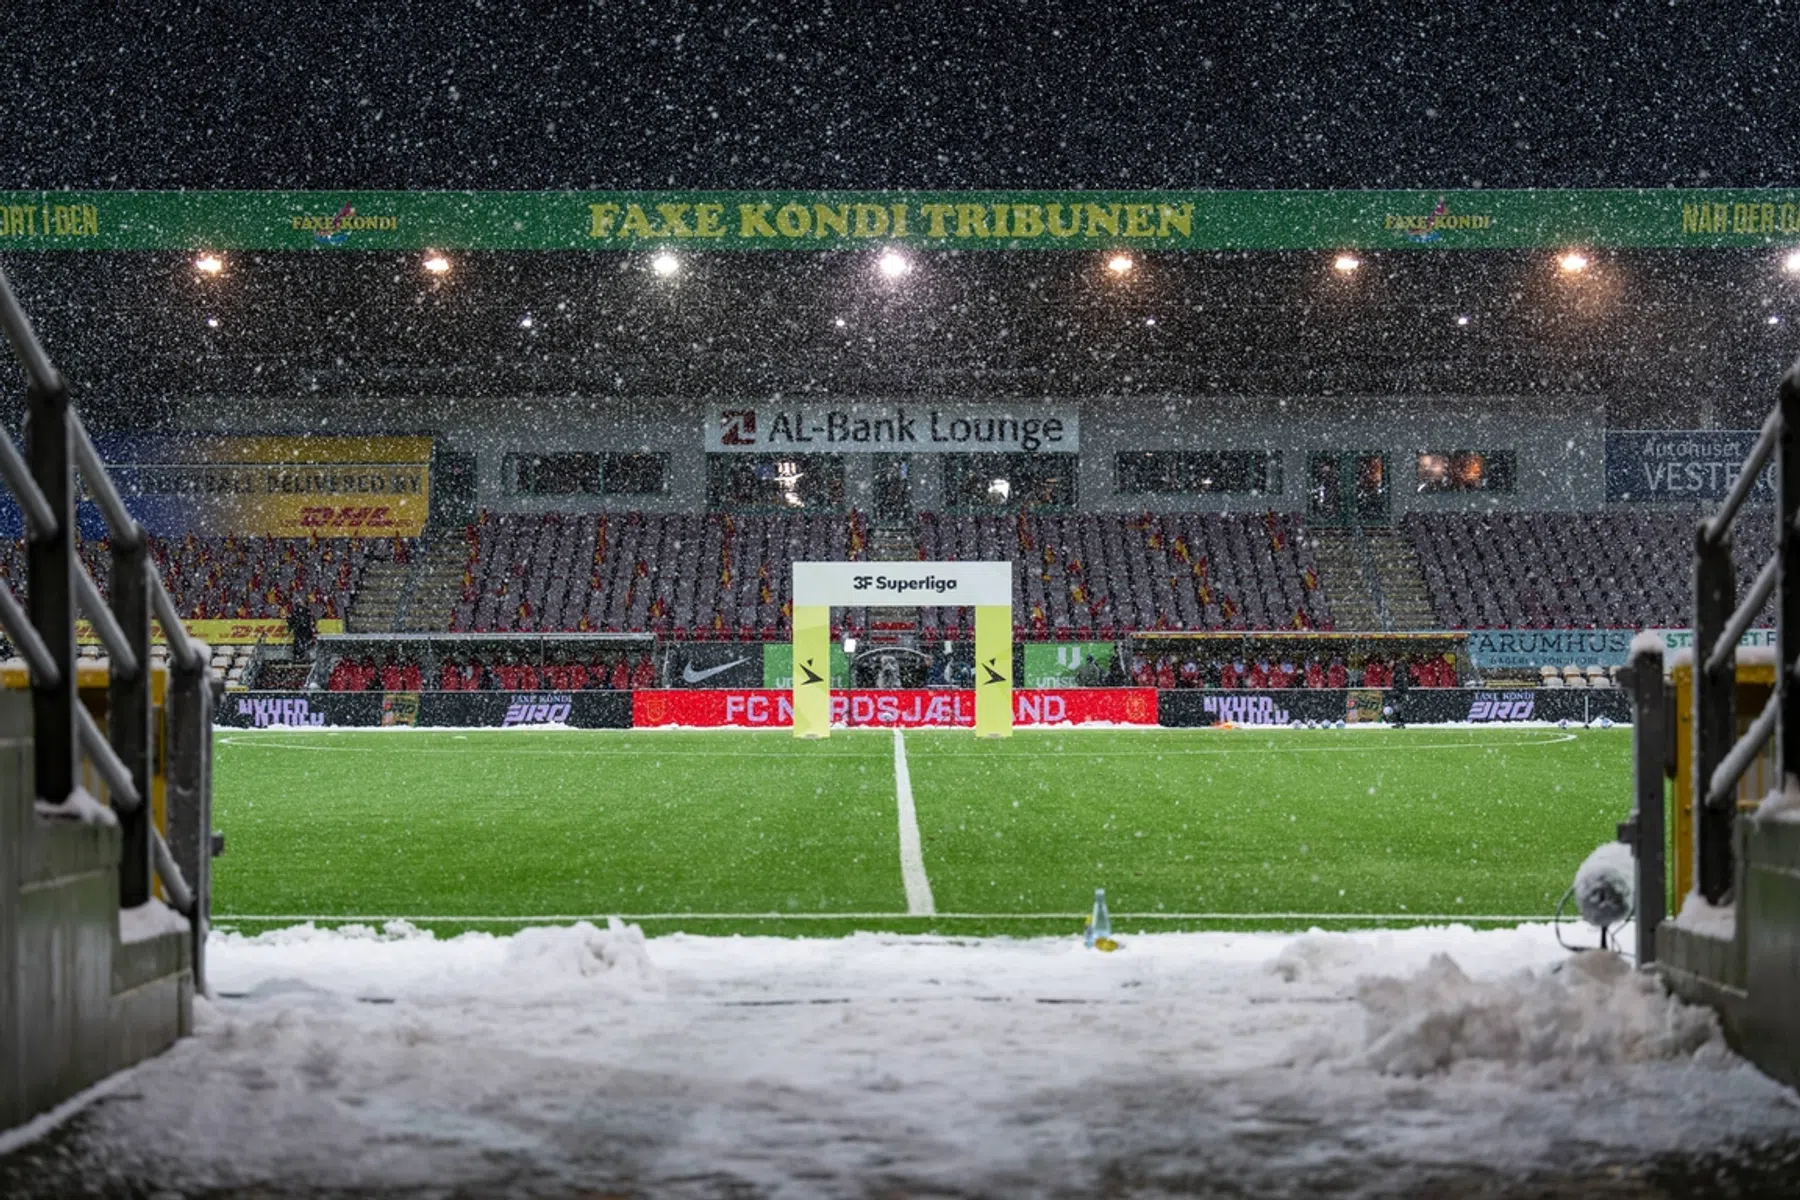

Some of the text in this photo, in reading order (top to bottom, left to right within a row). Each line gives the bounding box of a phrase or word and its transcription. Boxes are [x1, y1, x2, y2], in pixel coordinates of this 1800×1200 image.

[55, 205, 99, 236] DEN
[292, 215, 398, 230] FAXE KONDI
[589, 203, 1195, 239] FAXE KONDI TRIBUNEN
[1384, 215, 1491, 230] FAXE KONDI
[1733, 203, 1774, 234] DER
[769, 408, 1064, 451] AL-Bank Lounge
[267, 474, 386, 494] DELIVERED
[300, 507, 395, 527] DHL
[853, 575, 957, 593] 3F Superliga
[1502, 692, 1535, 700] KONDI
[727, 696, 769, 722] FC
